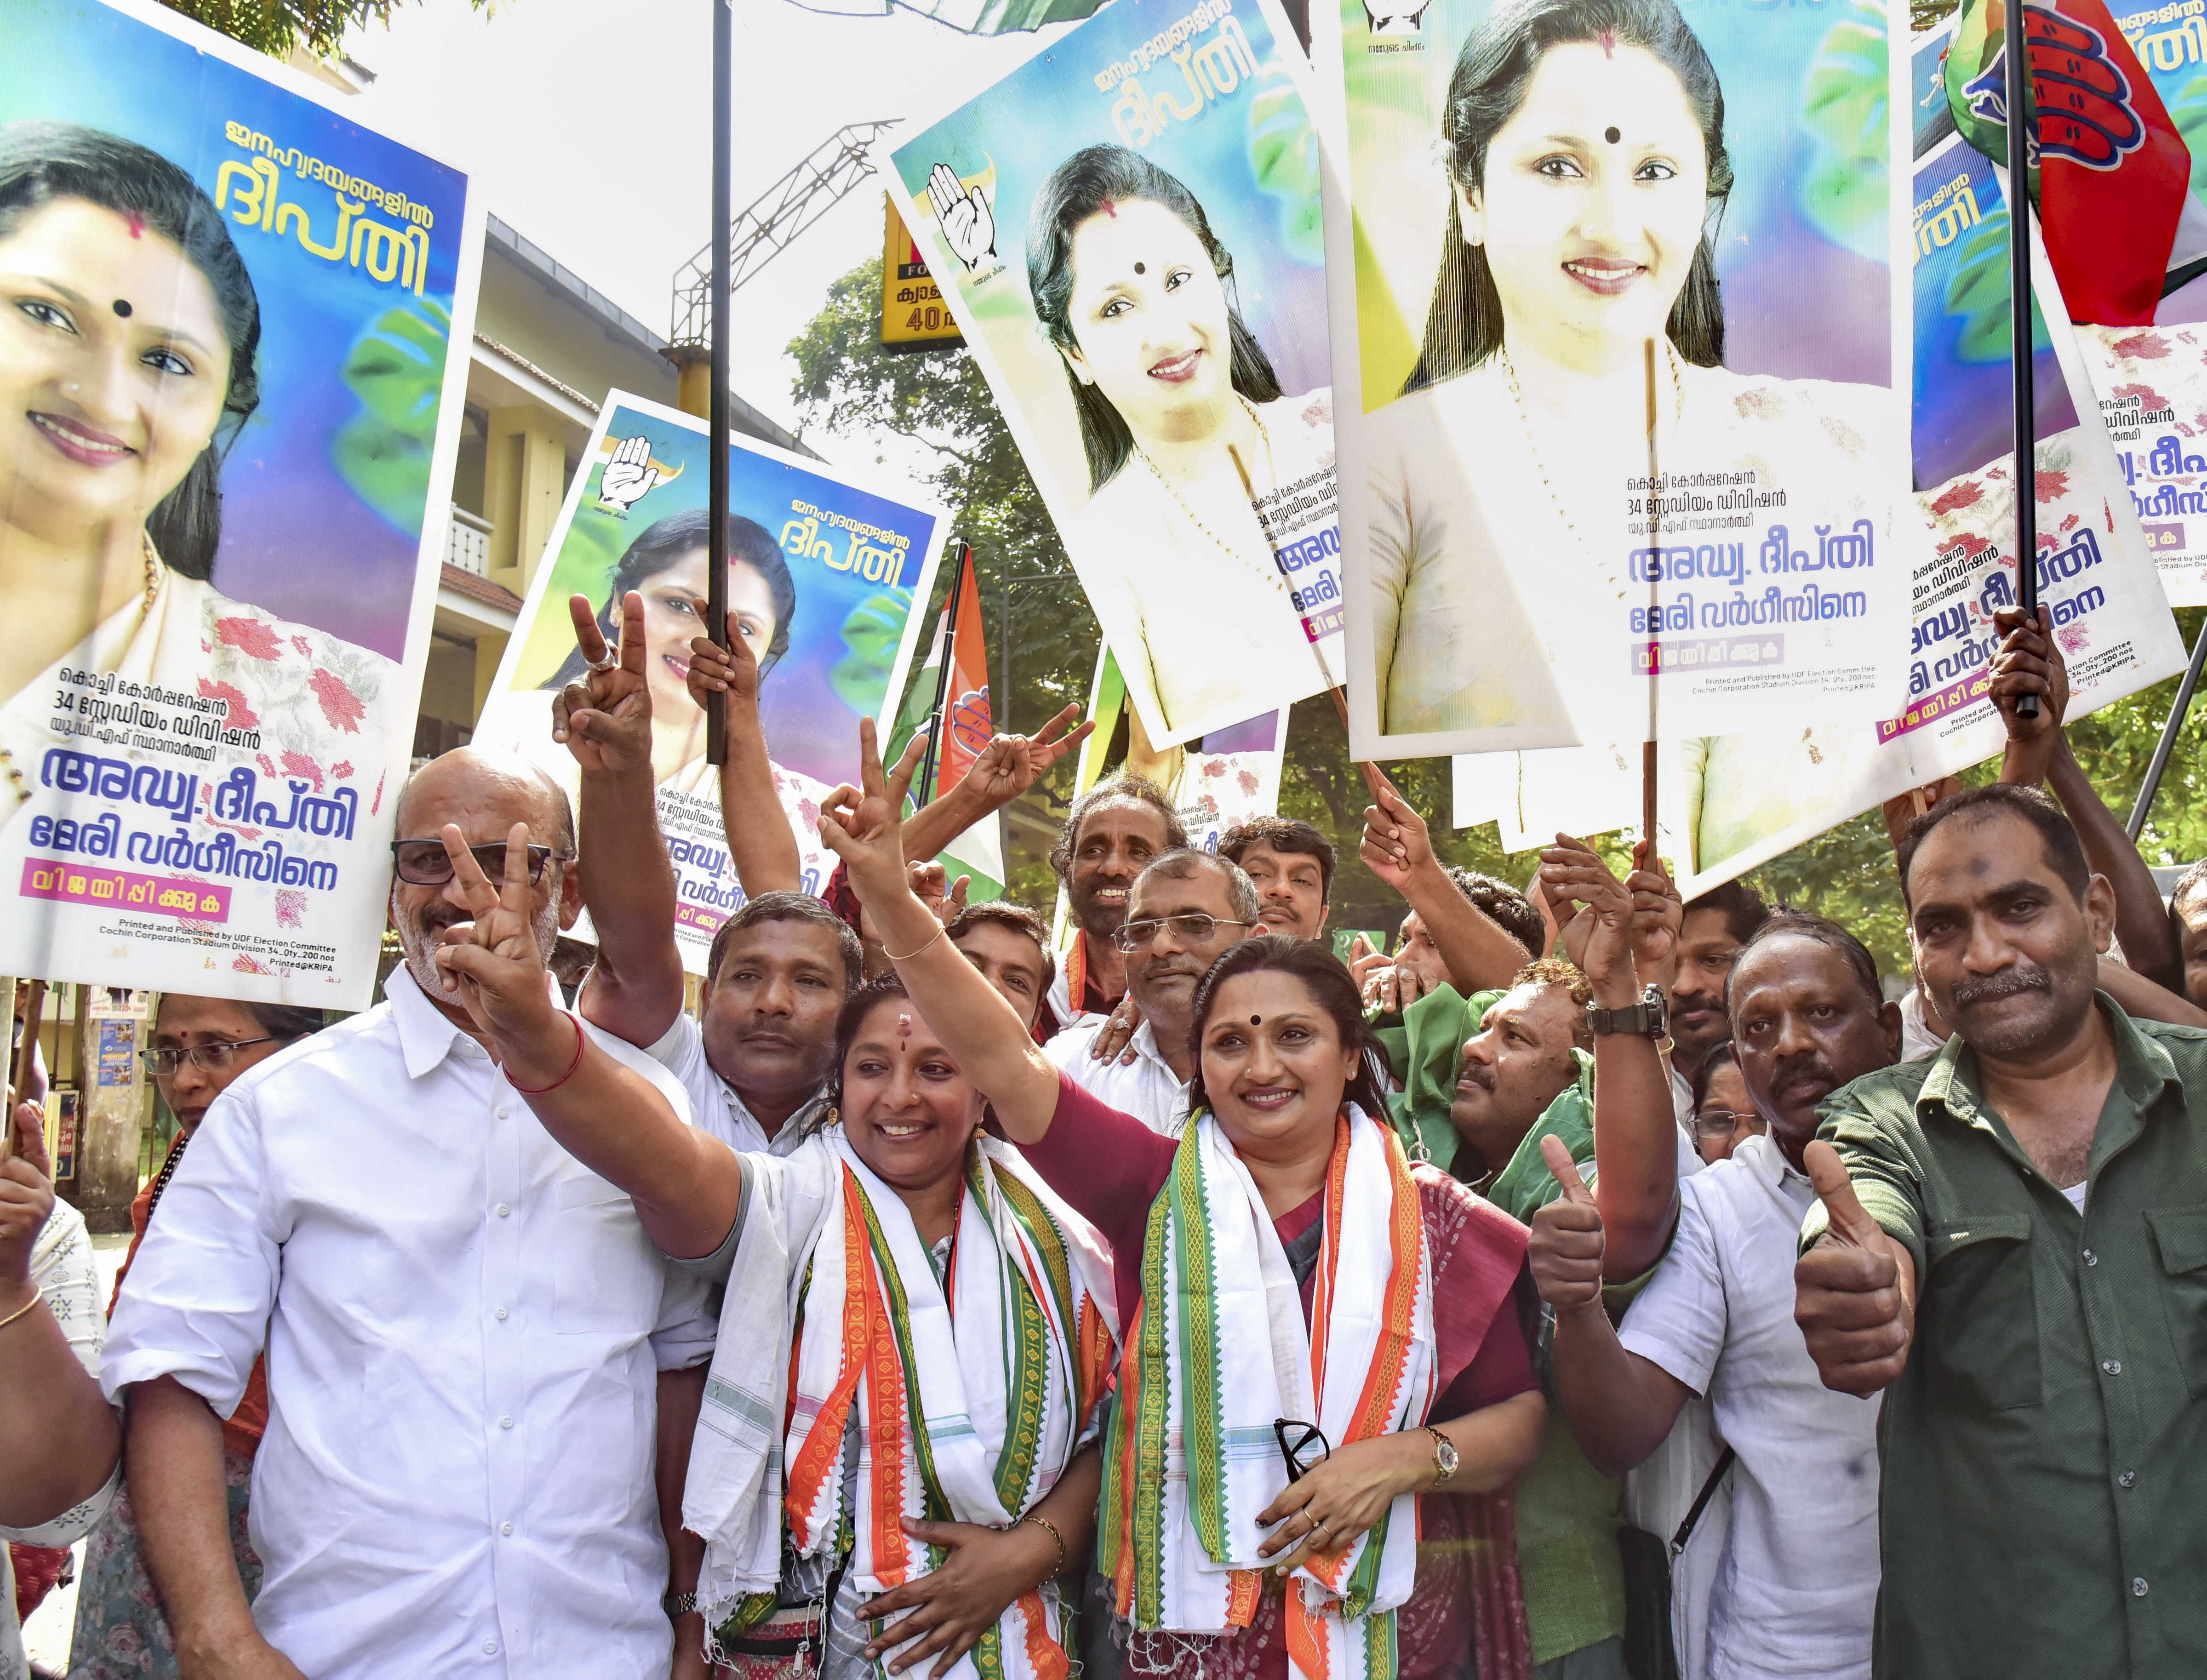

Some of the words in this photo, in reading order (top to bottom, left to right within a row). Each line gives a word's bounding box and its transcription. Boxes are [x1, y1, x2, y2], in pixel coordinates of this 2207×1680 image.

[1111, 15, 1258, 149] ദീപ്തി
[225, 120, 433, 229] ജനഹൃദയങ്ങളിൽ
[215, 155, 429, 297] ദീപ്തി
[908, 265, 927, 276] FO
[897, 285, 943, 304] ക്വാള
[906, 307, 940, 331] 40
[1628, 472, 1668, 493] കൊച്ചി
[1672, 469, 1755, 488] കോർപ്പറേഷൻ
[1252, 488, 1281, 511] കൊച്ചി
[1306, 502, 1338, 523] സ്ഥാനാർ
[1628, 499, 1641, 514] 34
[1647, 491, 1713, 519] സ്റ്റേഡിയം
[1717, 488, 1786, 509] ഡിവിഷൻ
[791, 498, 910, 551] ജനഹൃദയങ്ങളിൽ
[1258, 514, 1270, 529] 34
[1628, 516, 1688, 536] യു.ഡി.എഫ്
[1690, 512, 1753, 530] സ്ഥാനാർത്ഥി
[780, 516, 905, 589] ദീപ്തി
[1629, 543, 1751, 586] അഡ്വ.
[1760, 519, 1874, 573] ദീപ്തി
[1932, 544, 1999, 589] ഡിവിഷൻ
[1290, 569, 1340, 612] മേരി
[1630, 592, 1694, 633] മേരി
[1701, 583, 1866, 628] വർഗീസിനെ
[2066, 660, 2087, 674] ction
[2088, 641, 2131, 663] Committee
[2119, 647, 2133, 657] nos
[2076, 654, 2136, 685] Printed@KRIPA
[59, 668, 115, 696] കൊച്ചി
[118, 680, 227, 716] കോർപ്പറേഷൻ
[1718, 684, 1760, 692] Corporation
[53, 690, 74, 712] 34
[78, 696, 168, 730] സ്റ്റേഡിയം
[173, 714, 261, 750] ഡിവിഷൻ
[1951, 710, 1977, 726] Printed
[1978, 703, 1991, 713] and
[1940, 724, 1964, 737] Cochin
[132, 733, 217, 762] സ്ഥാനാർത്ഥി
[41, 748, 203, 823] അഡ്വ.
[214, 766, 359, 840] ദീപ്തി
[659, 788, 689, 805] കൊച്ചി
[667, 804, 714, 826] സ്റ്റേഡിയം
[1189, 811, 1219, 826] ഡിവിഷൻ
[29, 811, 122, 859] മേരി
[127, 827, 338, 891] വർഗീസിനെ
[32, 868, 220, 914] വിജയിപ്പിക്കുക
[100, 926, 133, 937] Cochin
[135, 931, 190, 944] Corporation
[193, 937, 229, 949] Stadium
[232, 943, 265, 953] Division
[119, 919, 154, 931] Printed
[156, 925, 173, 933] and
[176, 926, 220, 938] Published
[222, 932, 232, 941] by
[234, 934, 252, 943] UDF
[254, 936, 288, 948] Election
[291, 941, 336, 953] Committee
[680, 935, 710, 948] Corporation
[269, 958, 333, 972] Printed@KRIPA
